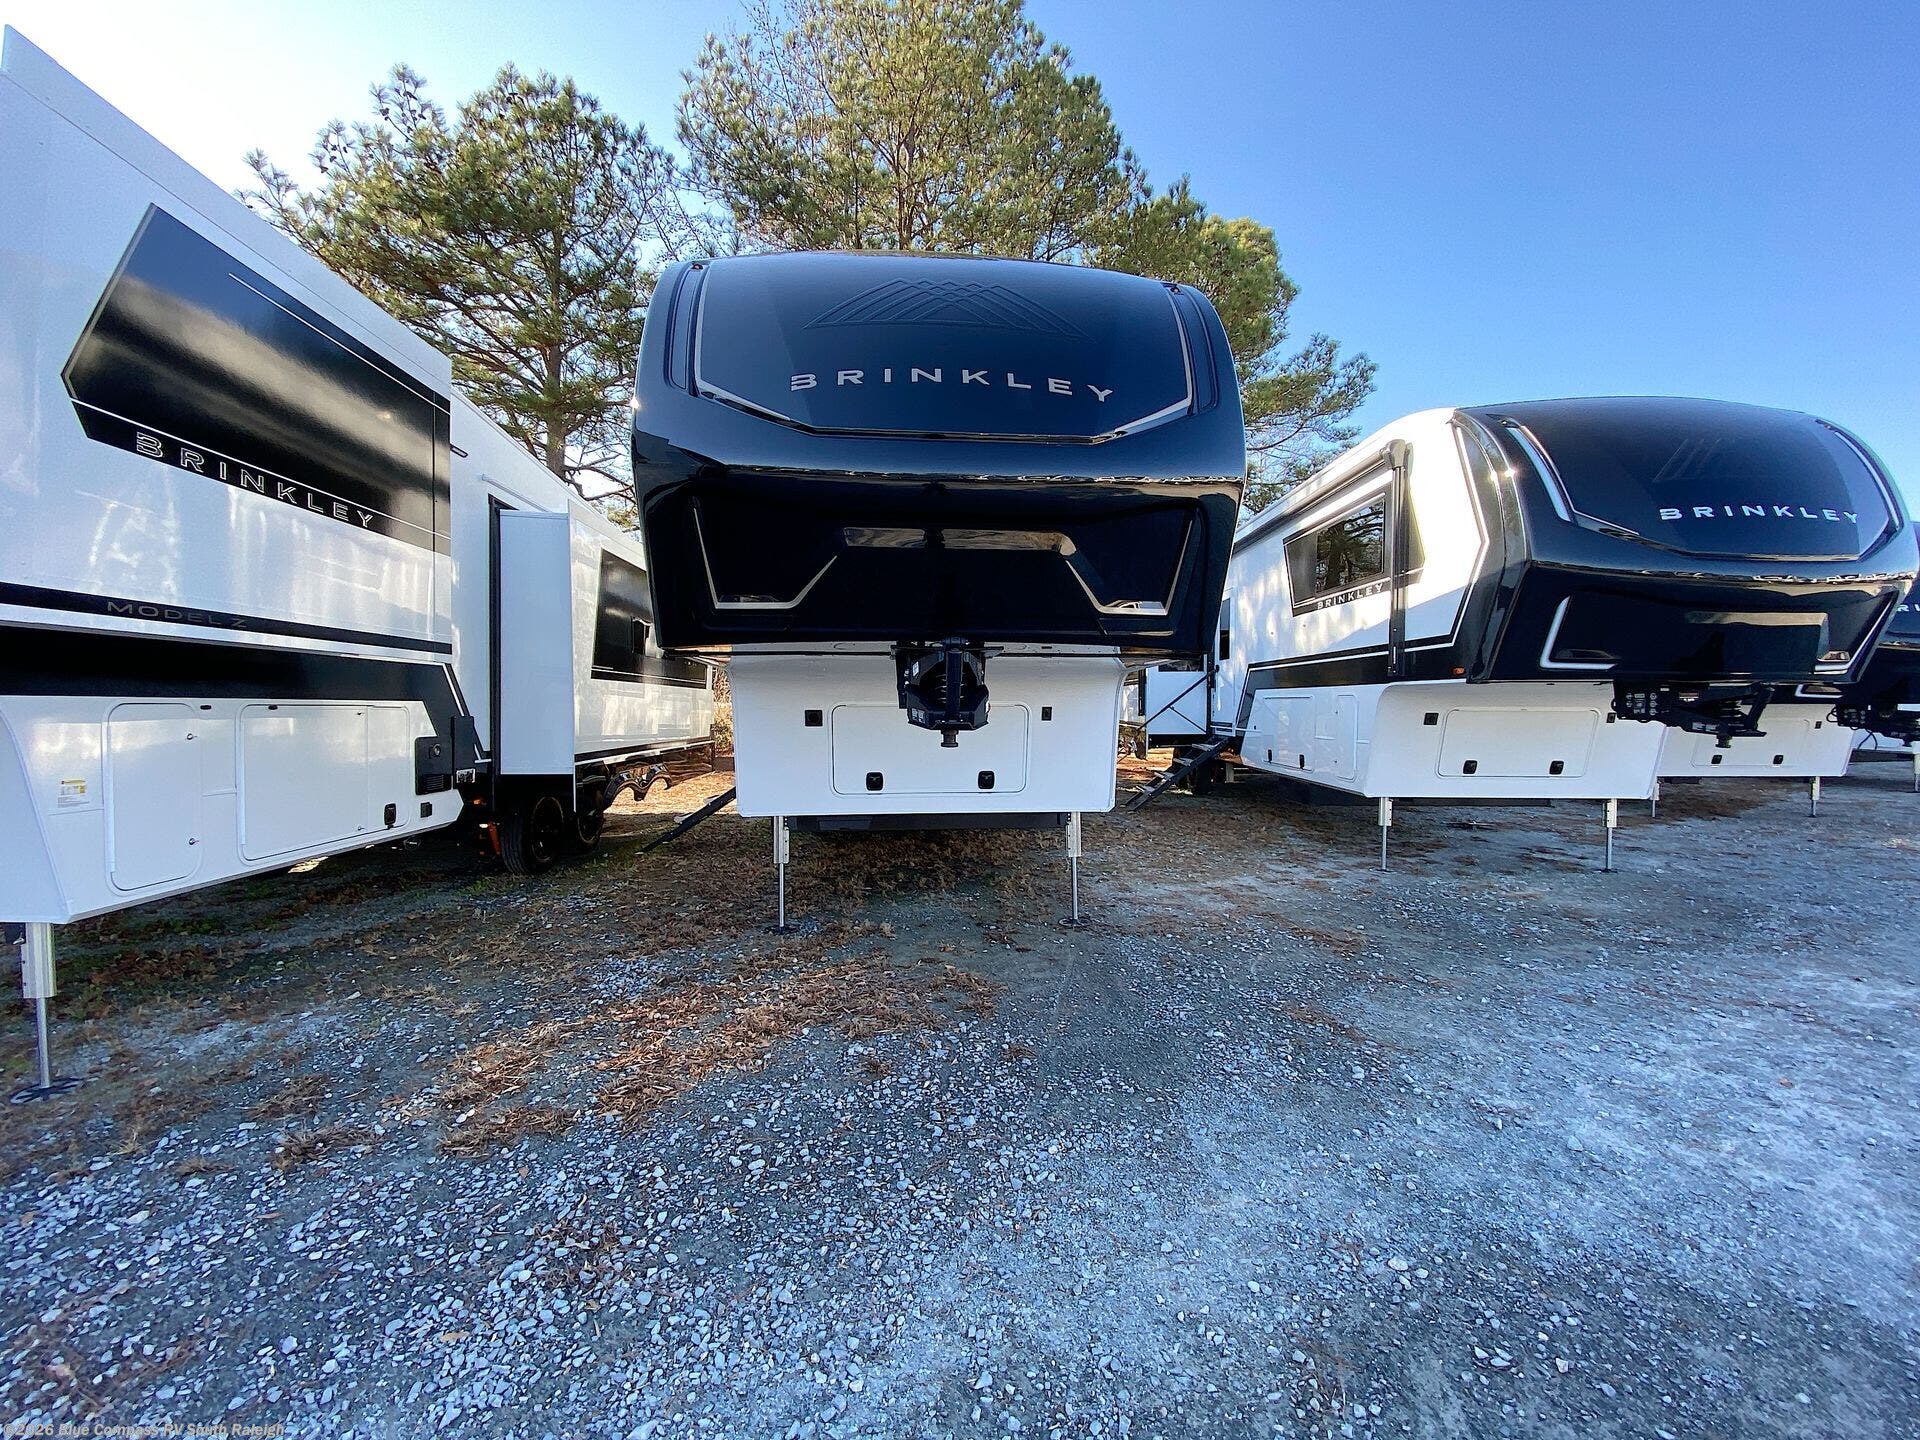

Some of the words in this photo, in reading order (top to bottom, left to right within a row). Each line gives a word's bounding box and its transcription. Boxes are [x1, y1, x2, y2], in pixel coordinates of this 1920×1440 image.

[789, 366, 1114, 403] BRINKLEY
[135, 431, 375, 528] BRINKLEY
[1659, 505, 1858, 524] BRINKLEY
[1317, 582, 1384, 610] BRINKLEY
[107, 601, 222, 625] MODEL
[232, 618, 248, 628] Z
